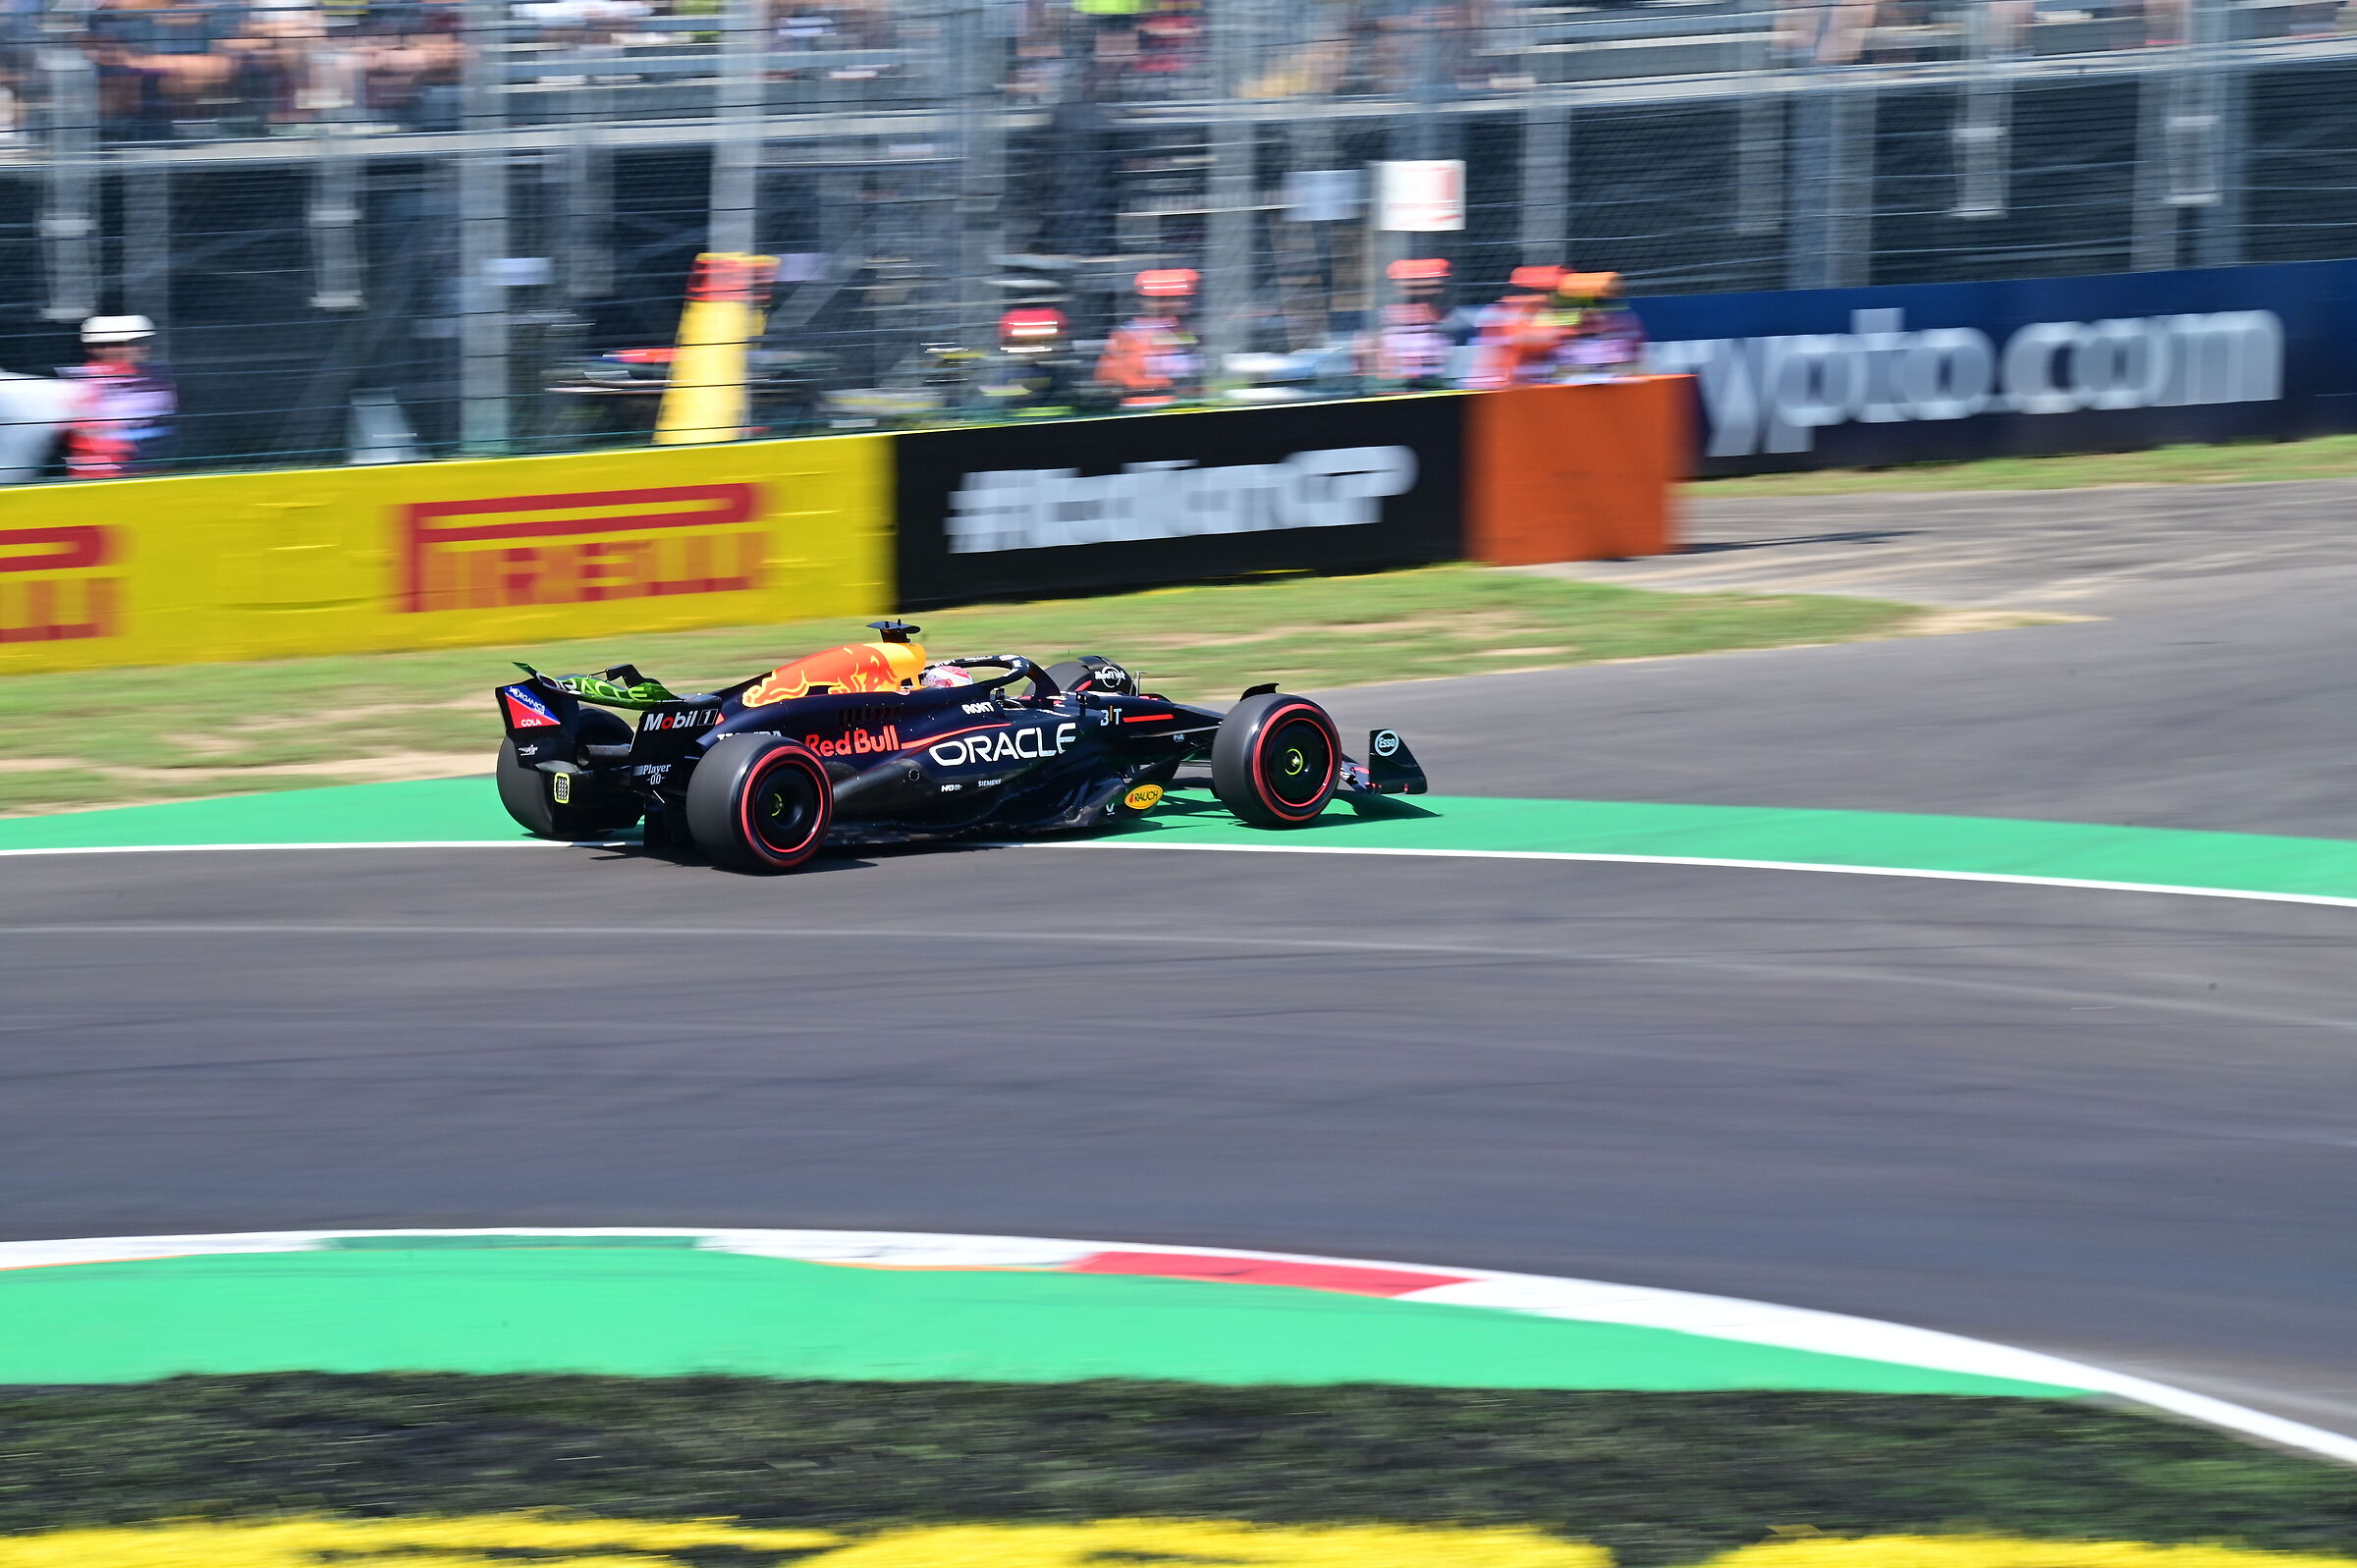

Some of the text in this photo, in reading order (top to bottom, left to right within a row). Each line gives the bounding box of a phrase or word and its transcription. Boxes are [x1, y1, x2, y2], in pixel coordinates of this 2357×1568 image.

[521, 718, 542, 728] COLA
[643, 710, 698, 731] Mobil
[805, 725, 900, 757] Red Bull
[928, 723, 1076, 767] ORACLE
[642, 764, 672, 776] Player
[1134, 790, 1159, 802] RAUCH
